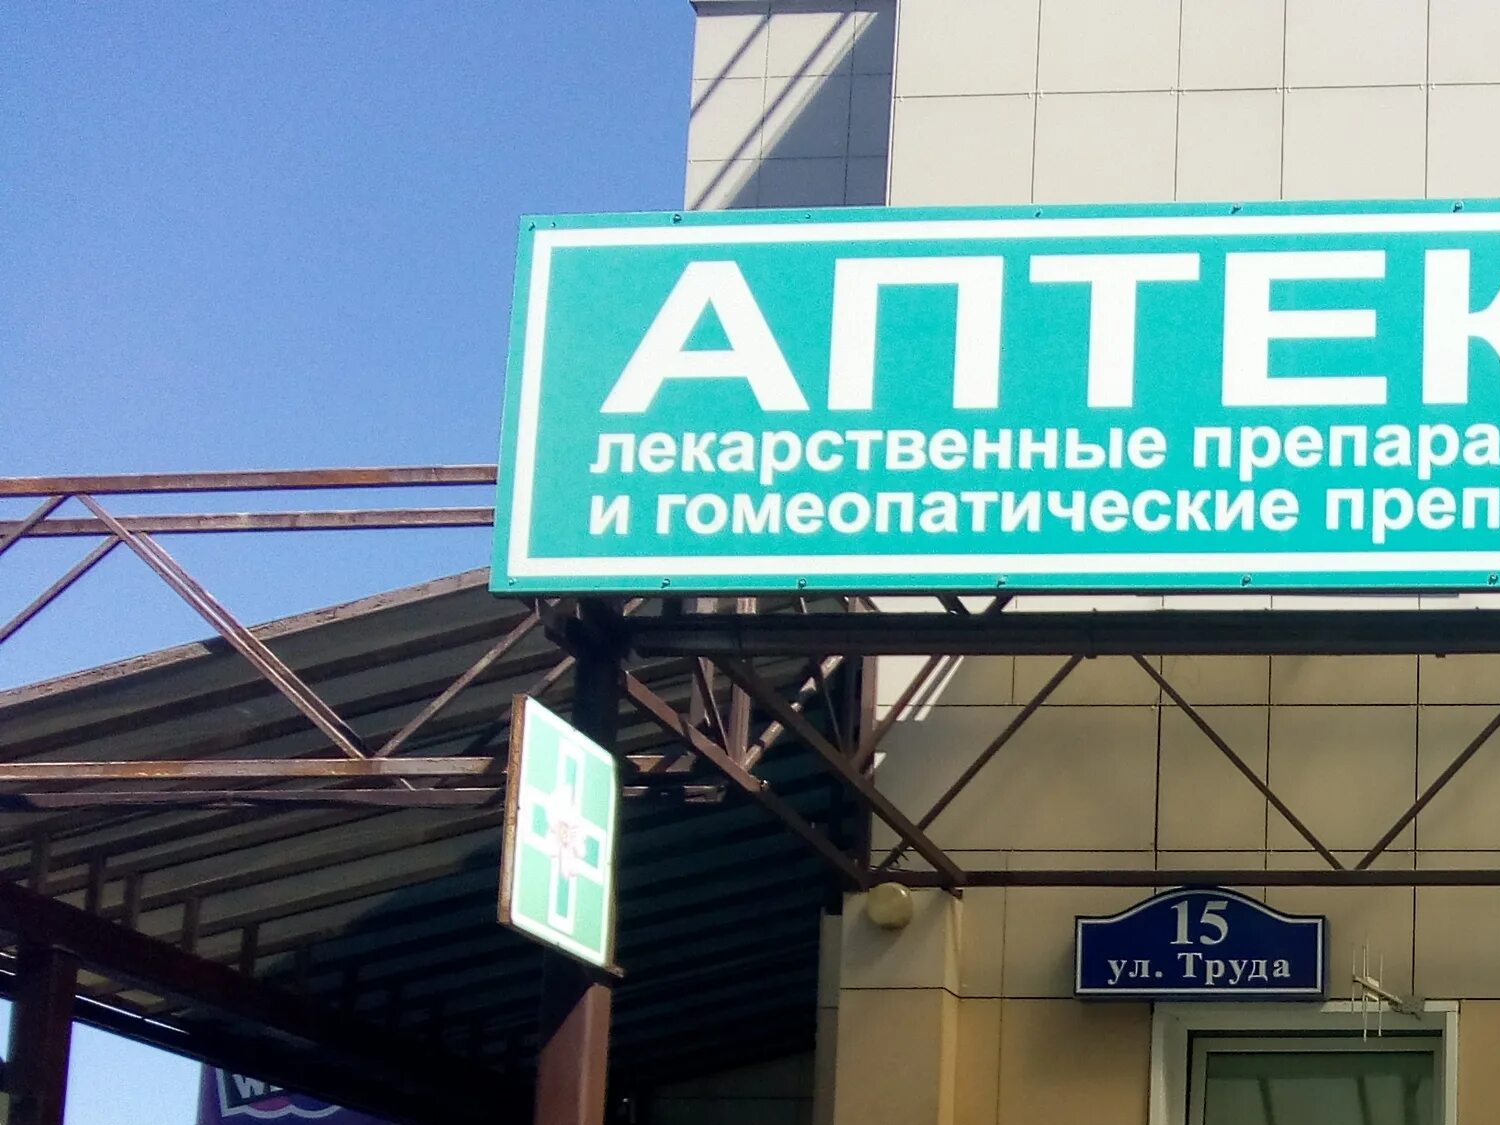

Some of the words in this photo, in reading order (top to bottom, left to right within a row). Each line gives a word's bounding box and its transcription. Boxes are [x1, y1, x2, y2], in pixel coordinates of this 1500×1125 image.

[589, 427, 1167, 486] лекарственные
[589, 494, 630, 535] и
[656, 488, 1299, 535] гомеопатические
[1170, 900, 1229, 945] 15
[1108, 958, 1163, 985] ул.
[1177, 952, 1291, 985] Труда
